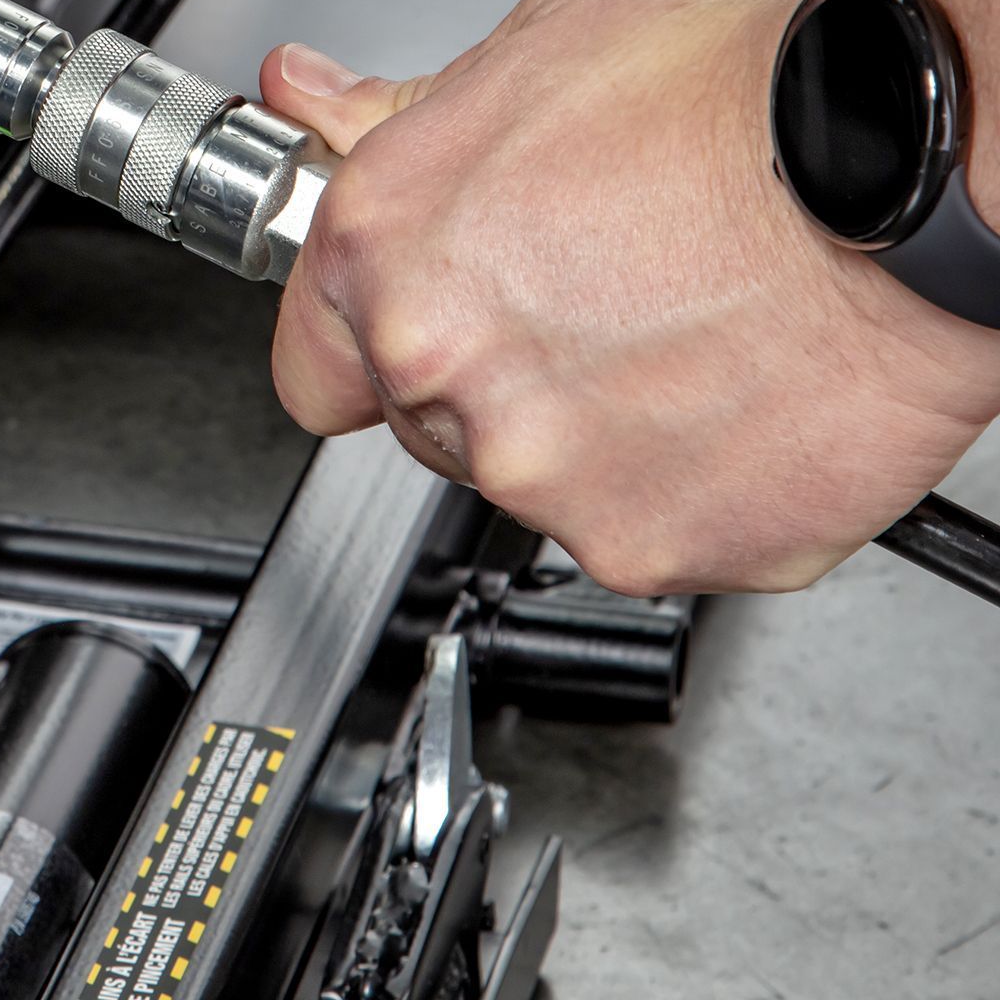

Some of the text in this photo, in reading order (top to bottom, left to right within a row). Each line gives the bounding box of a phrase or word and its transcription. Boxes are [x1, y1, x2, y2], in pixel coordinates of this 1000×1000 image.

[187, 879, 207, 897] LES
[161, 891, 182, 908] LES
[116, 911, 157, 964] L'ÉCART
[133, 917, 186, 994] PINCEMENT
[105, 965, 133, 977] À
